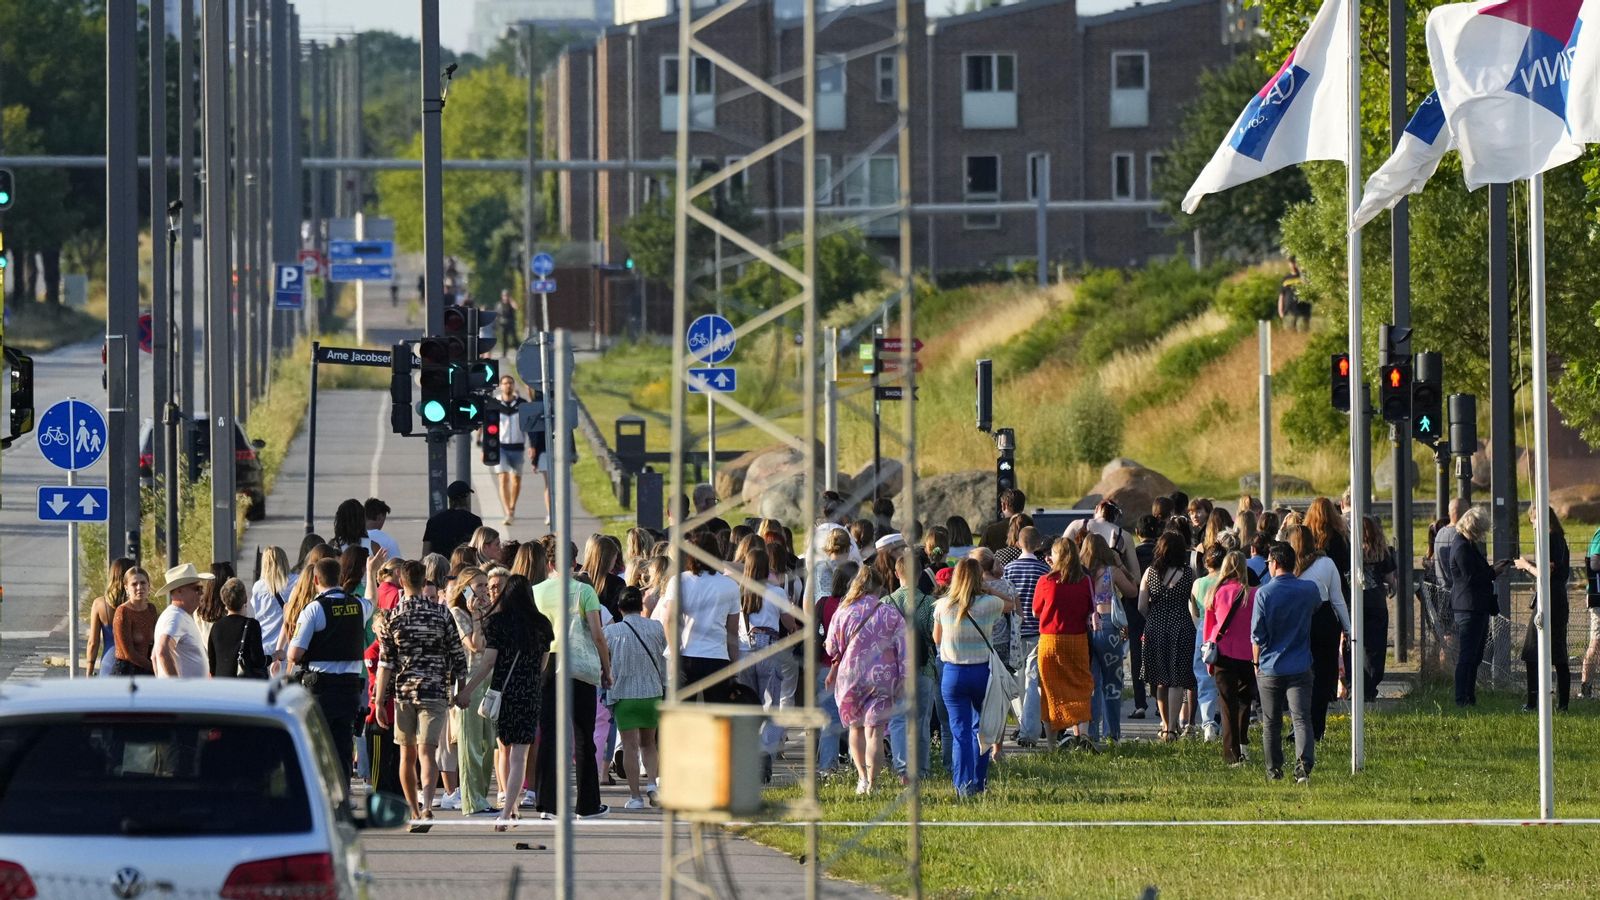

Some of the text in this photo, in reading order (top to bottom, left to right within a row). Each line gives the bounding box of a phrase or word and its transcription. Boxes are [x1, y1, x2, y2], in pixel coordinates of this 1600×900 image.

[281, 267, 298, 290] P
[326, 350, 349, 360] Arne
[333, 605, 359, 615] POLITI
